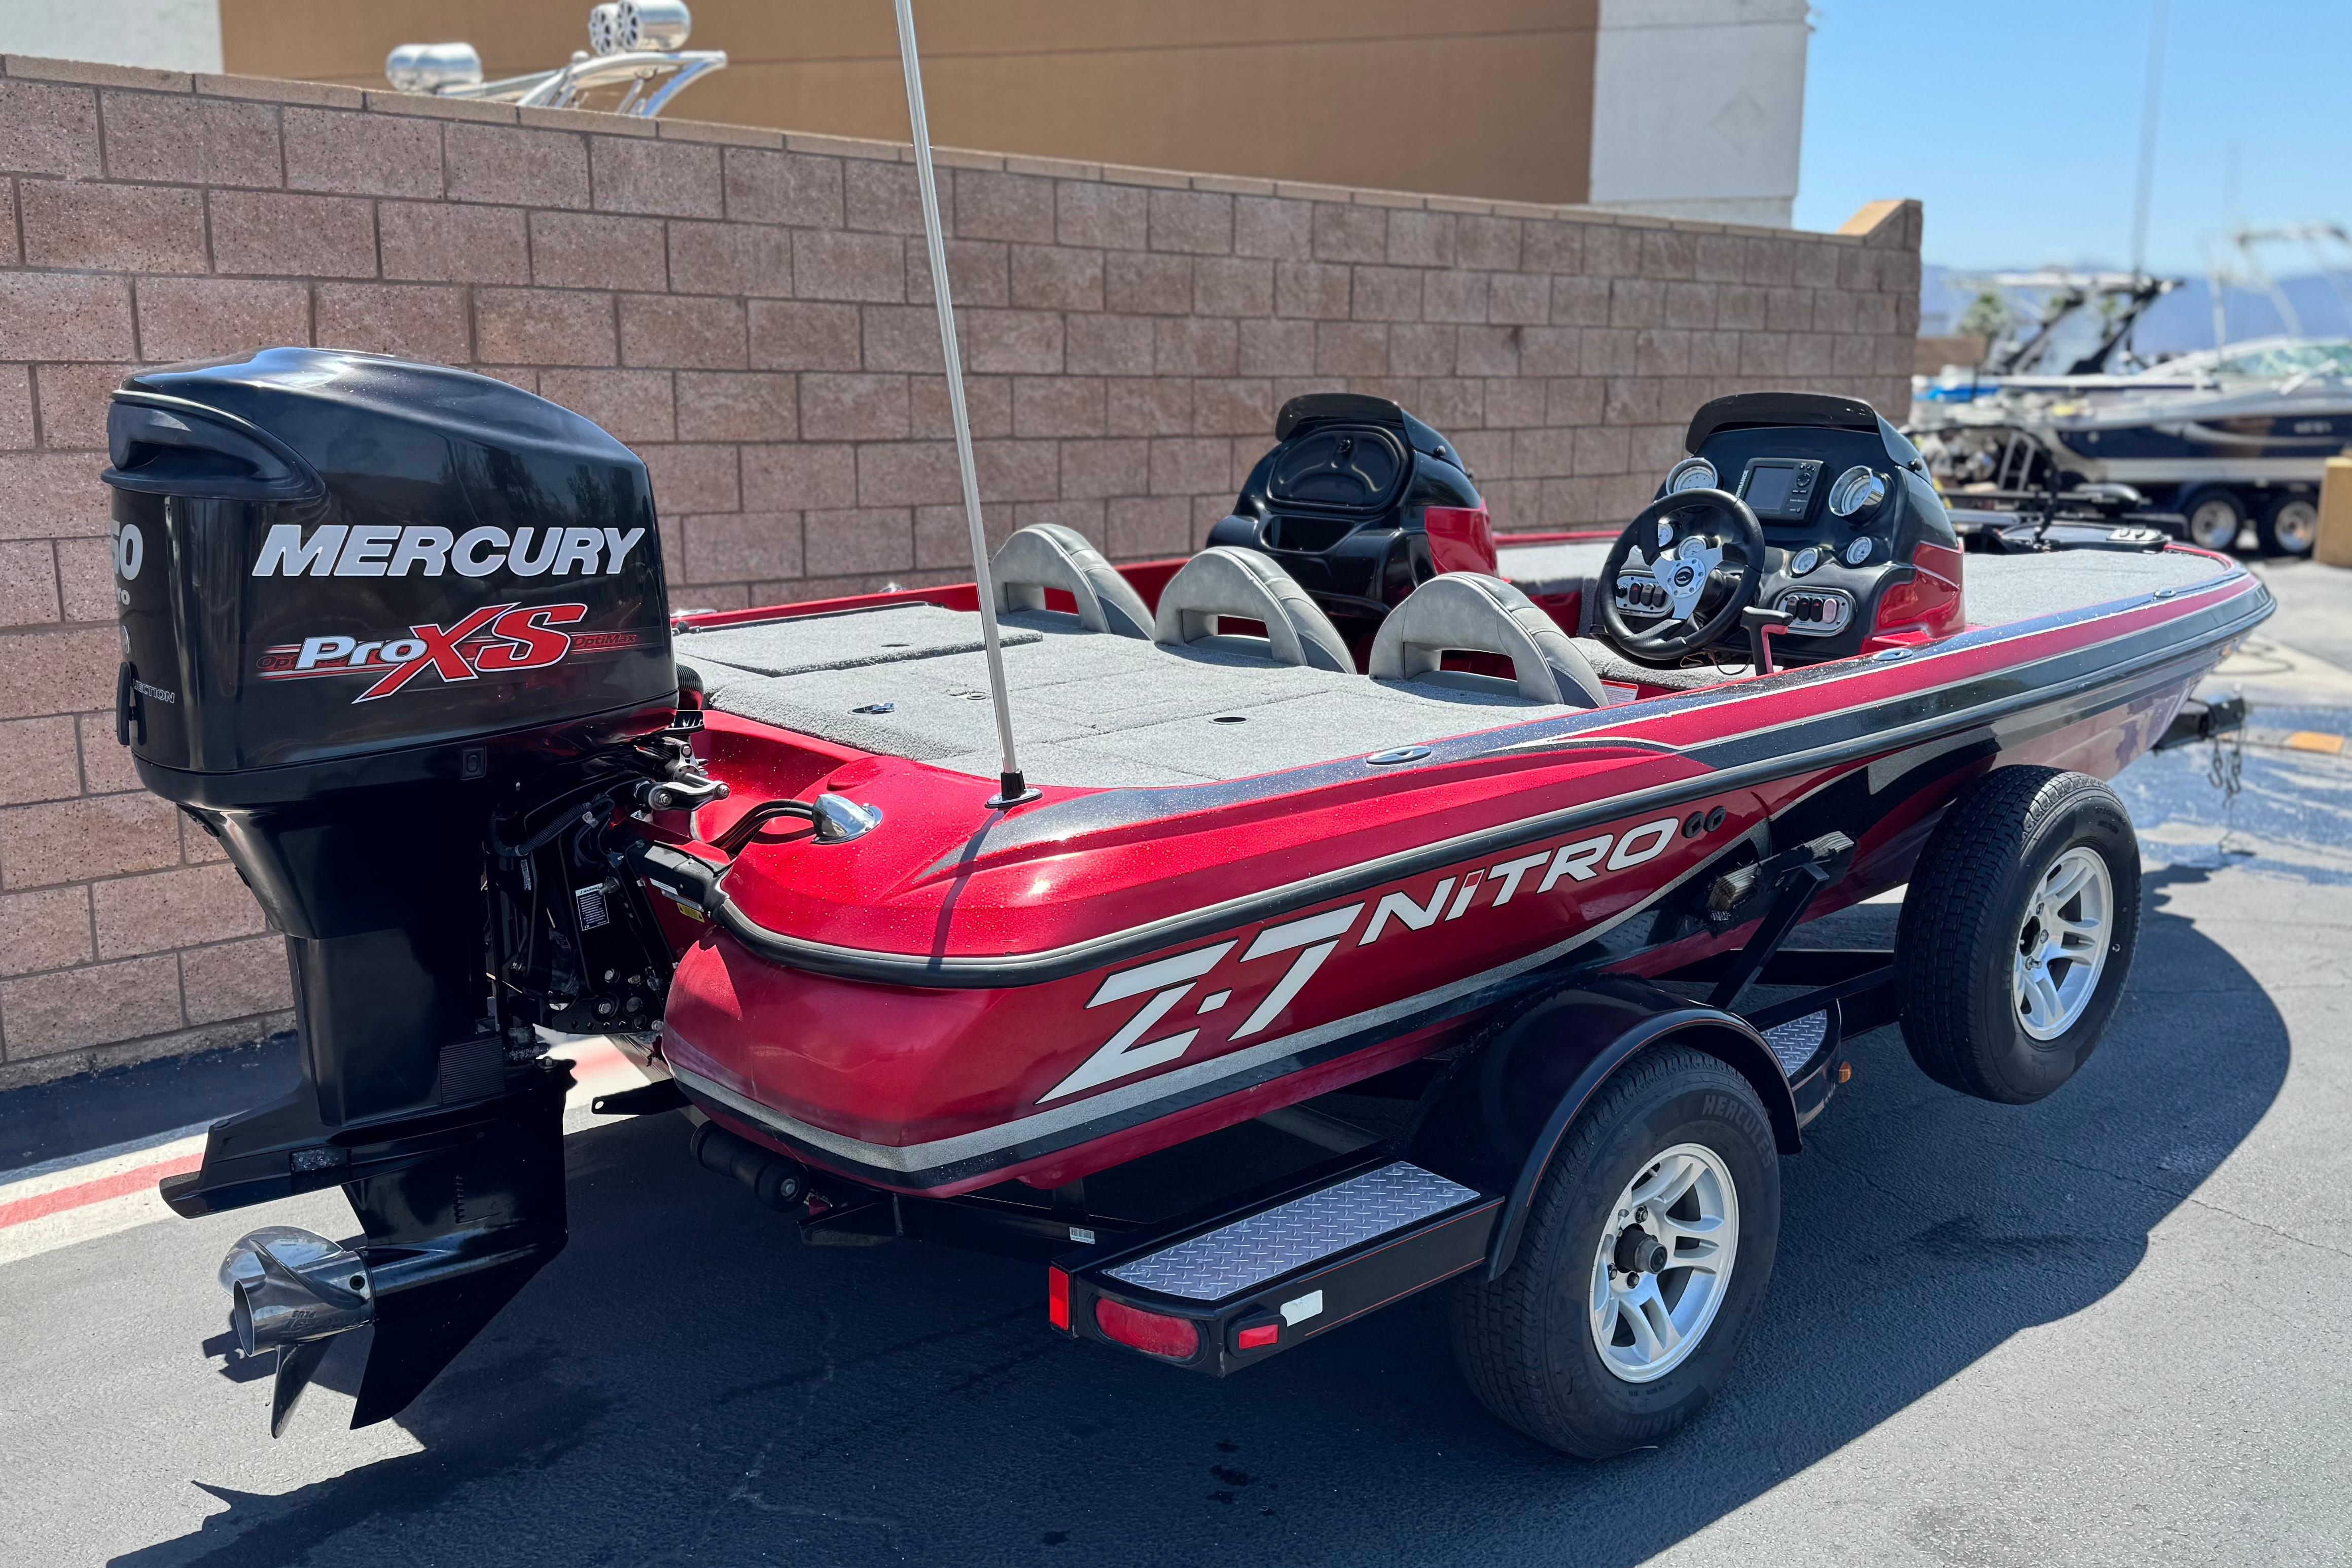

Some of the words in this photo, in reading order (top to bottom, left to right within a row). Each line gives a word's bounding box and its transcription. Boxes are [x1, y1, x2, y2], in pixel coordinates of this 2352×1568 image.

[1735, 470, 1749, 498] OWRANCE
[252, 524, 646, 577] MERCURY
[574, 633, 637, 648] OptiMax
[1701, 1093, 1774, 1168] HERCULES
[291, 1309, 317, 1318] PLUS
